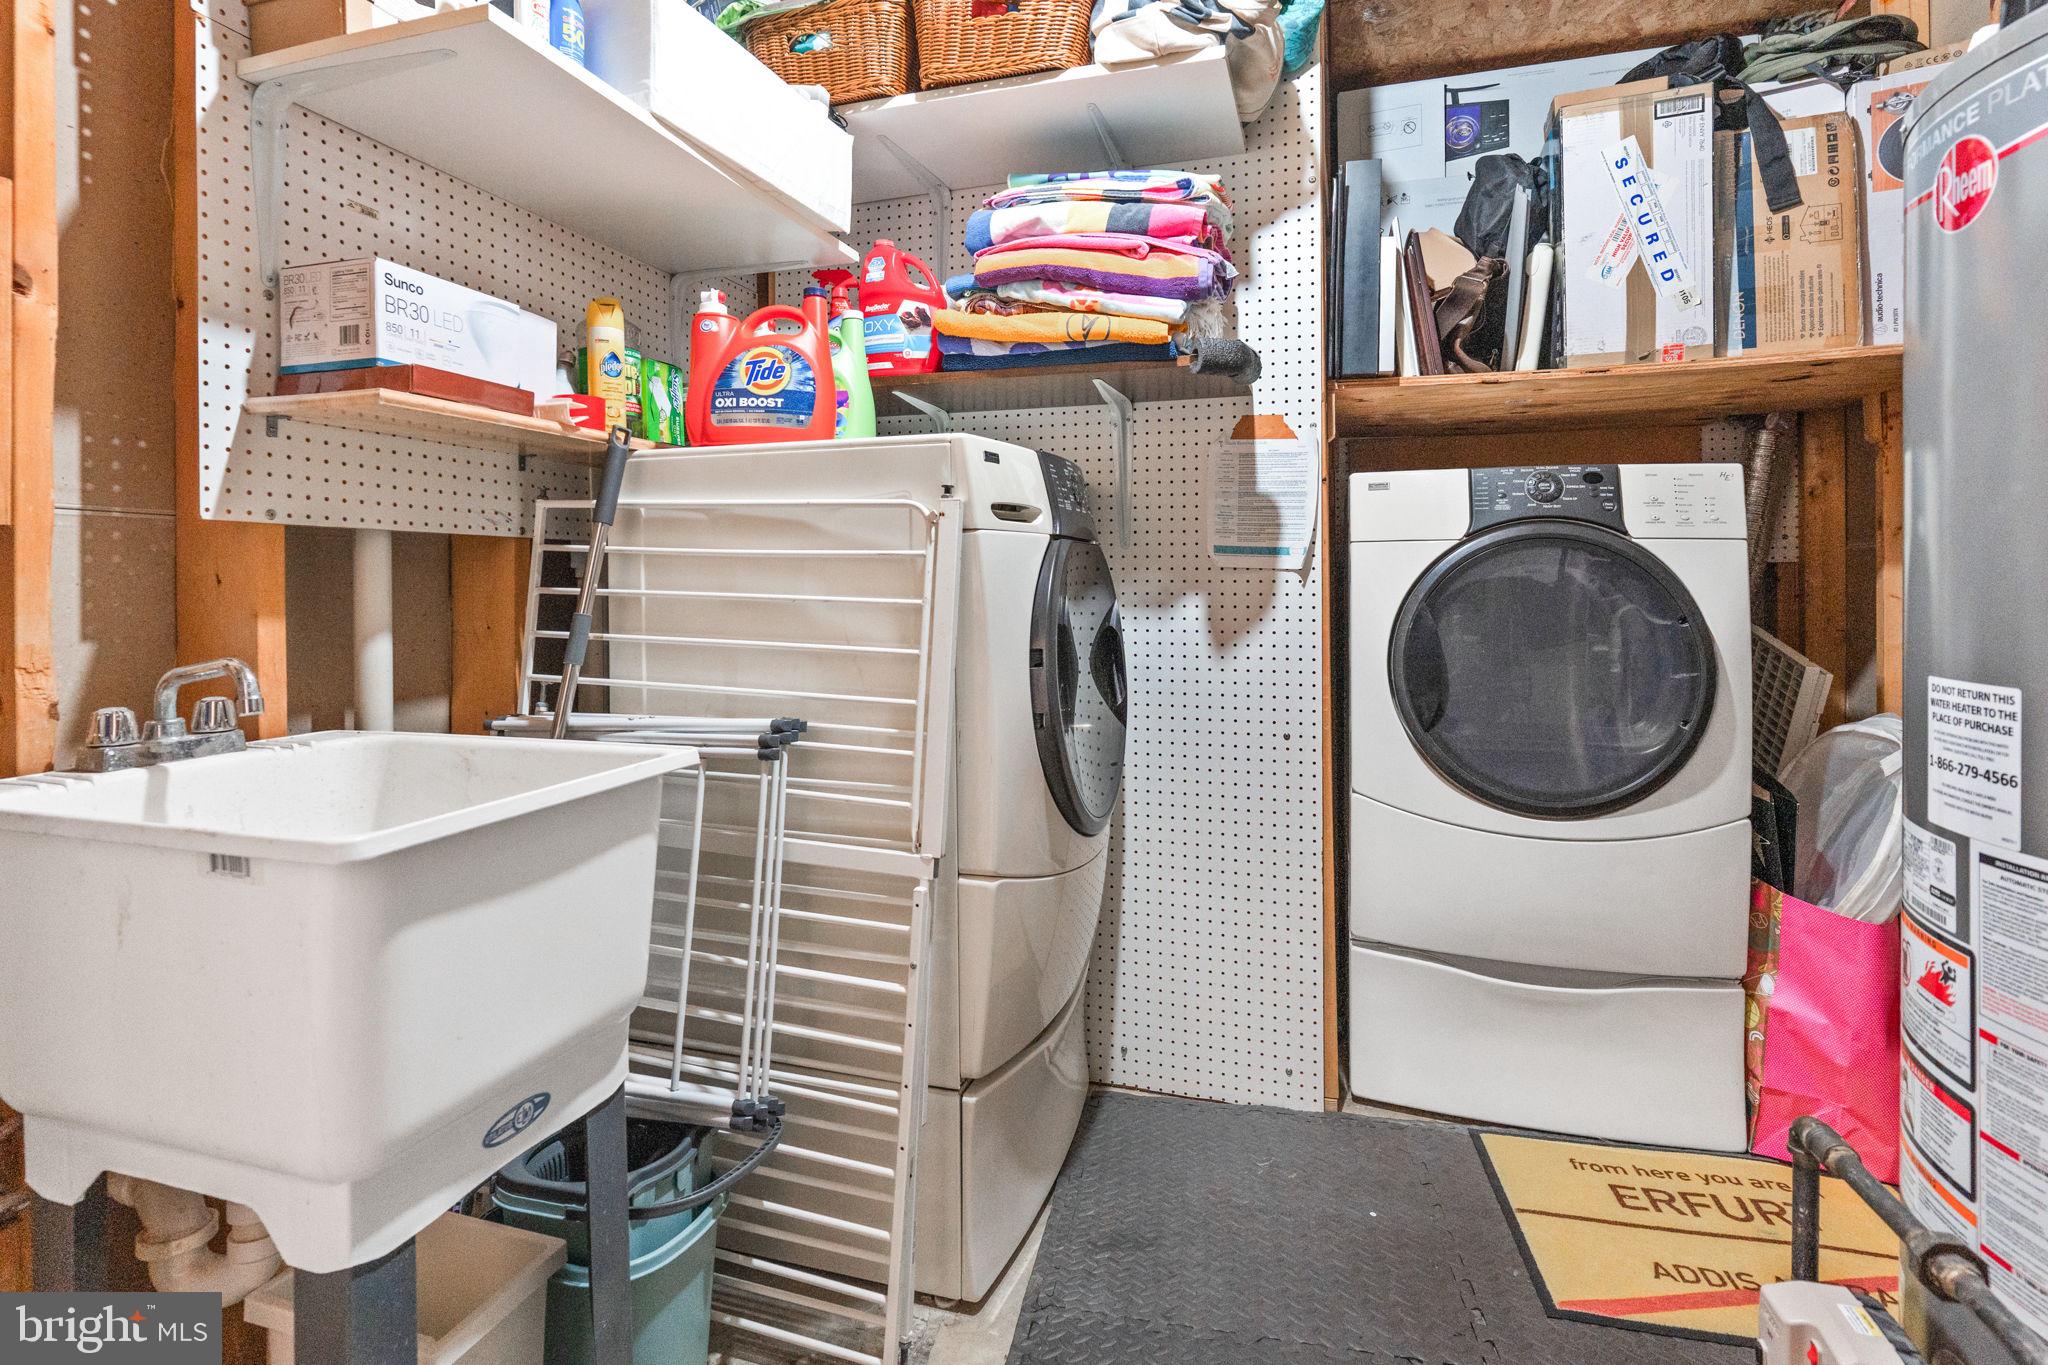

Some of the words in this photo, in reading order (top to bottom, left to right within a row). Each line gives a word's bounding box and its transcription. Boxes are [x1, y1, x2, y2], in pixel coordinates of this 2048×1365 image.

[1938, 145, 1993, 222] Rheem
[1615, 157, 1675, 282] SECURED
[283, 273, 305, 286] BR30
[384, 272, 424, 296] Sunco
[1875, 273, 1884, 322] audio-technica
[385, 294, 430, 324] BR30
[434, 309, 464, 333] LED
[386, 321, 403, 335] 850
[864, 318, 895, 333] OXY
[1734, 291, 1746, 339] DENON
[745, 358, 786, 386] Tide
[715, 398, 737, 408] OXI
[739, 397, 785, 408] BOOST
[1932, 683, 1941, 693] DO
[1942, 685, 1955, 697] NOT
[1957, 688, 1991, 702] RETURN
[1993, 693, 2015, 705] THIS
[1930, 698, 1951, 710] WATER
[1952, 701, 1982, 716] HEATER
[1984, 707, 1996, 718] TO
[1998, 709, 2018, 721] THE
[1932, 712, 1951, 724] PLACE
[1953, 716, 1963, 726] OF
[1964, 719, 2014, 736] PURCHASE
[1929, 755, 2018, 788] 1-866-279-4566
[1569, 1158, 1628, 1174] from
[1636, 1164, 1690, 1182] here
[1696, 1171, 1742, 1187] you
[1751, 1178, 1792, 1192] are
[1608, 1183, 1822, 1231] ERFUR
[1653, 1261, 1761, 1292] ADDIS
